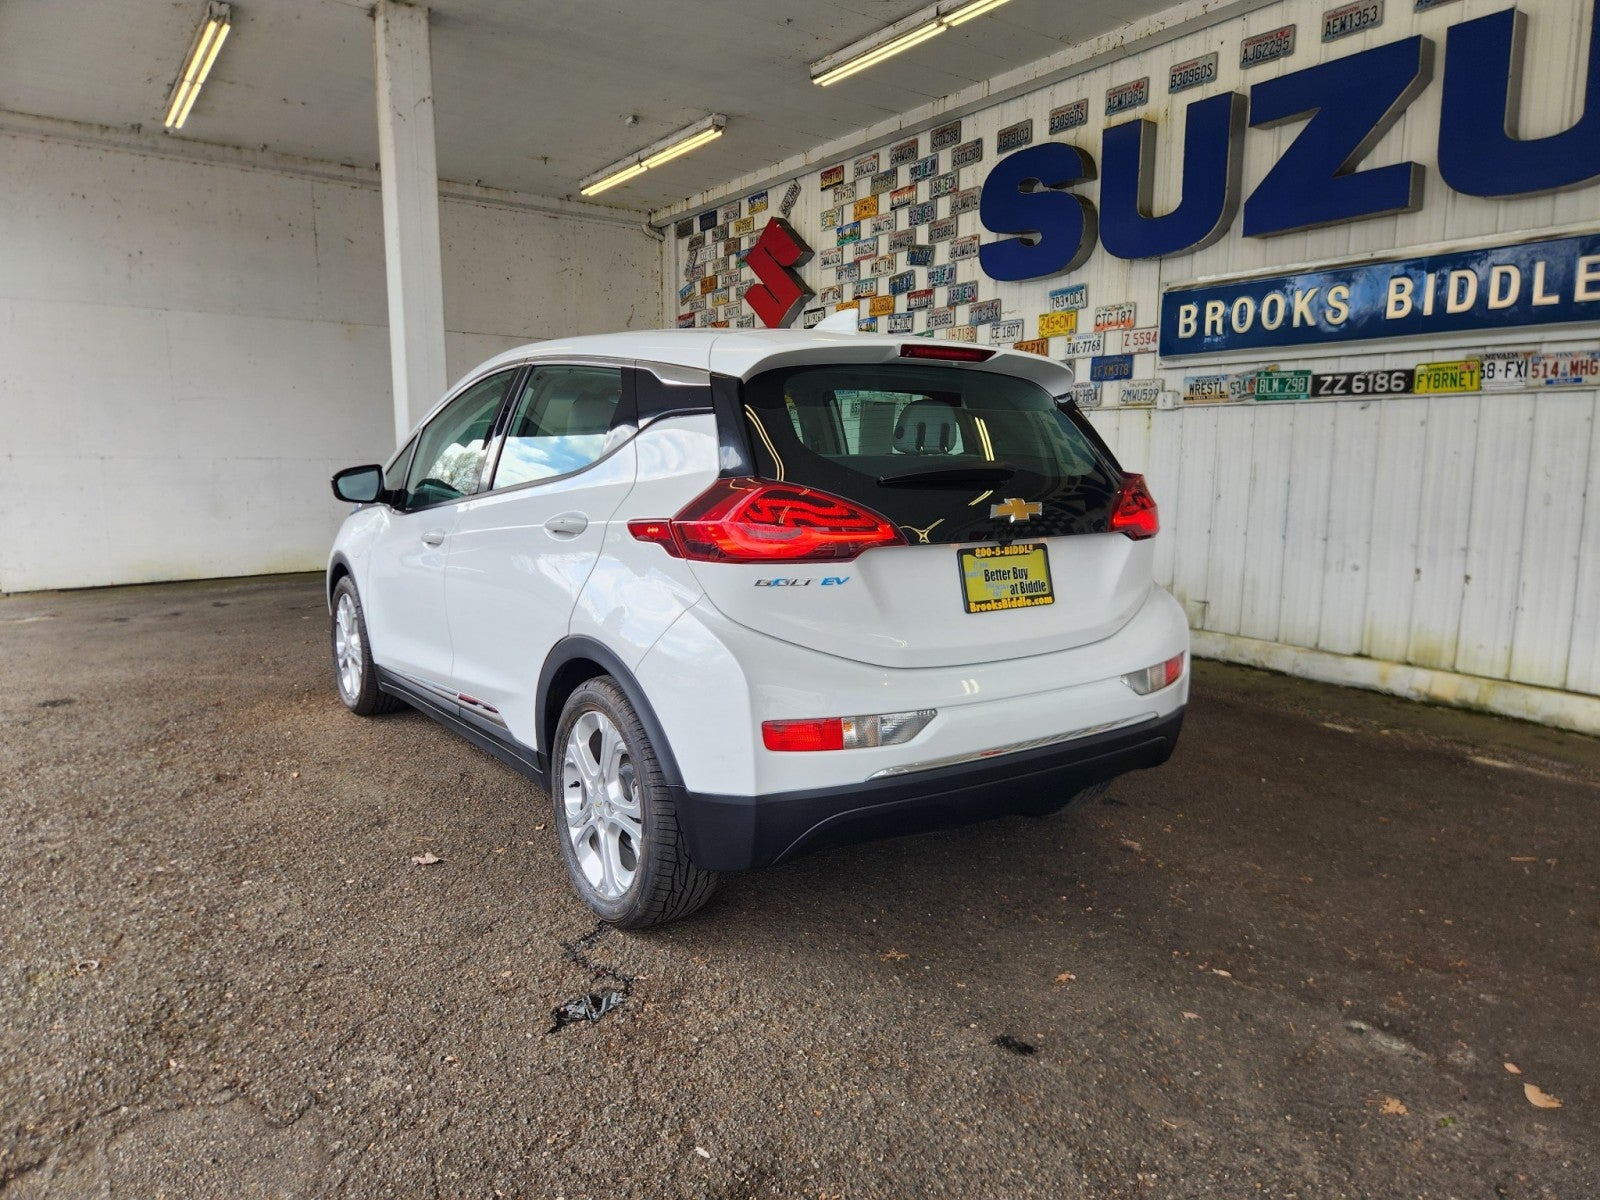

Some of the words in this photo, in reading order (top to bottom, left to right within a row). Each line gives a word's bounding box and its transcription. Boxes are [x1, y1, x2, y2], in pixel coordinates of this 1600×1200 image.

[1324, 5, 1378, 37] AEW1353
[1242, 34, 1290, 64] AJG2295
[1051, 296, 1065, 309] 783
[1178, 285, 1350, 339] BROOKS
[1386, 255, 1600, 320] BIDDLE
[1096, 312, 1113, 327] CTC
[1115, 309, 1132, 325] 187
[1003, 325, 1020, 338] 1807
[1133, 330, 1158, 346] 5594
[1531, 362, 1559, 379] 514
[1569, 358, 1599, 376] MHG
[1188, 382, 1225, 395] WRESTL
[1285, 377, 1305, 393] 298
[1319, 375, 1347, 395] ZZ
[1351, 372, 1406, 394] 6186
[1416, 370, 1477, 390] FYBRNET
[754, 578, 816, 587] BOLT
[821, 576, 851, 586] EV
[984, 568, 1011, 582] Better
[1012, 566, 1029, 580] Buy
[1010, 583, 1019, 595] at
[1020, 580, 1047, 594] Biddle
[969, 595, 1053, 613] BrooksBiddle.com
